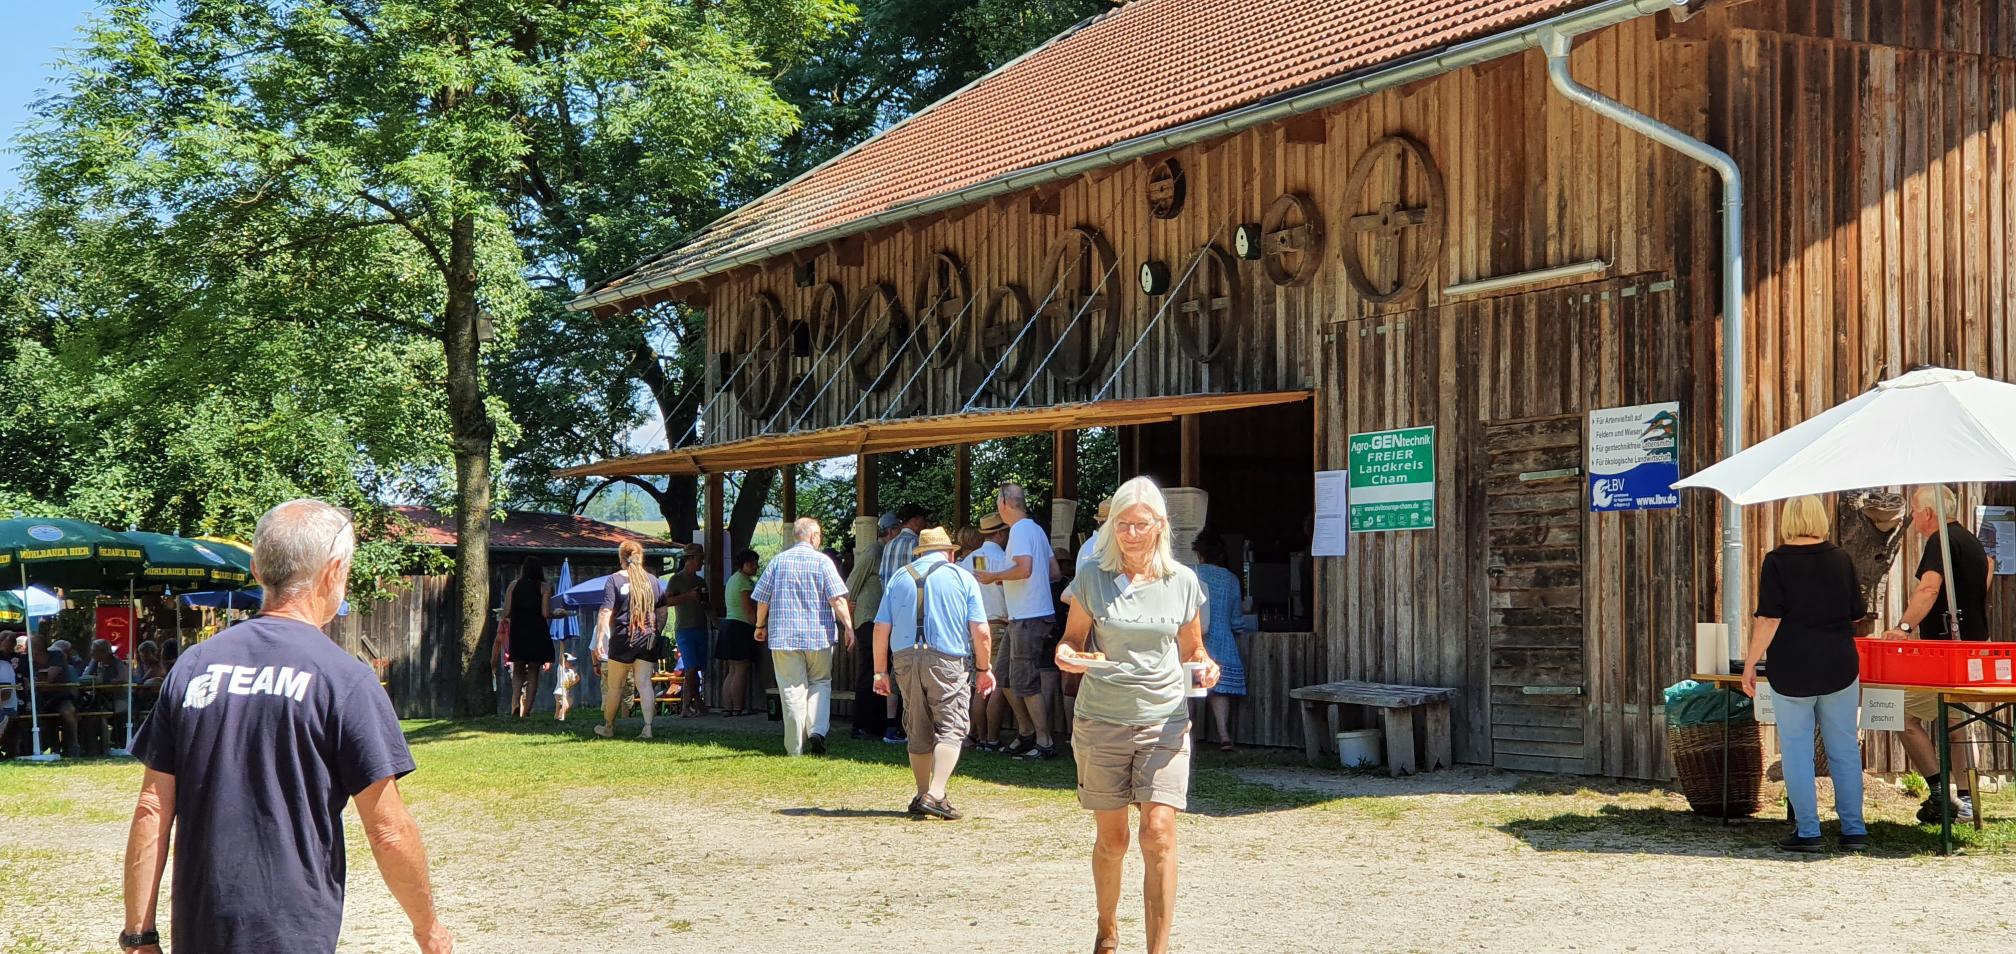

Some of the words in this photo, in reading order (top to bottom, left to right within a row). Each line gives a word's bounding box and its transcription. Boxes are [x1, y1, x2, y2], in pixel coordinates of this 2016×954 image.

[1351, 434, 1431, 453] Agro-GENtechnik
[1368, 450, 1413, 462] FREIER
[1360, 461, 1423, 473] Landkreis
[1372, 475, 1407, 484] Cham
[1636, 494, 1677, 505] www.lbv.de
[206, 663, 312, 702] TEAM
[1869, 699, 1897, 709] Schmutz-
